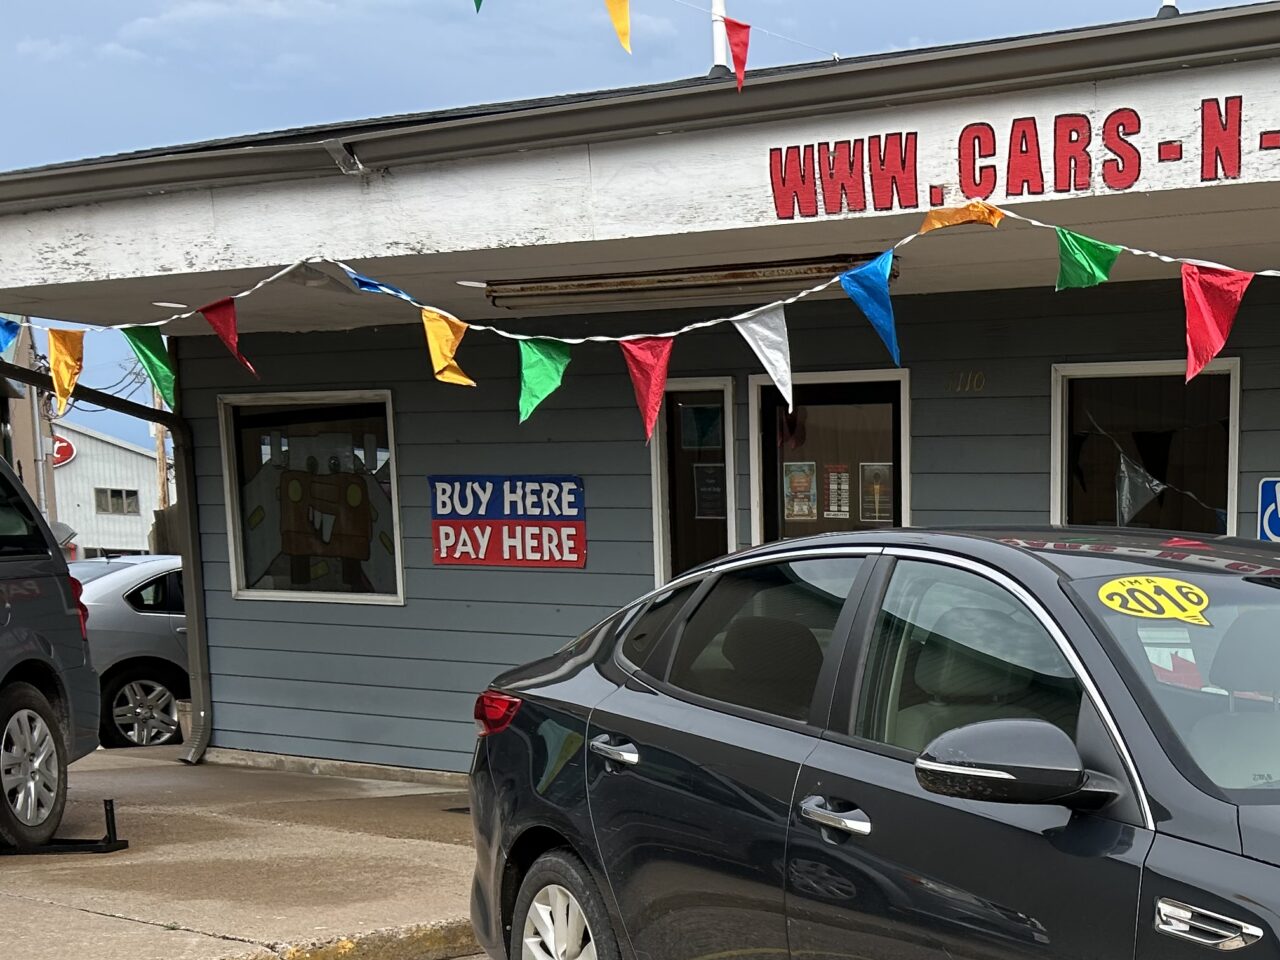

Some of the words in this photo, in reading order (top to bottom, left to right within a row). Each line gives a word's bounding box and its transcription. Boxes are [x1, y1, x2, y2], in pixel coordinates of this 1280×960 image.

[434, 481, 493, 516] BUY
[503, 481, 579, 516] HERE
[438, 525, 492, 560] PAY
[502, 525, 578, 561] HERE
[1118, 578, 1143, 587] I'M
[1105, 584, 1204, 615] 2016
